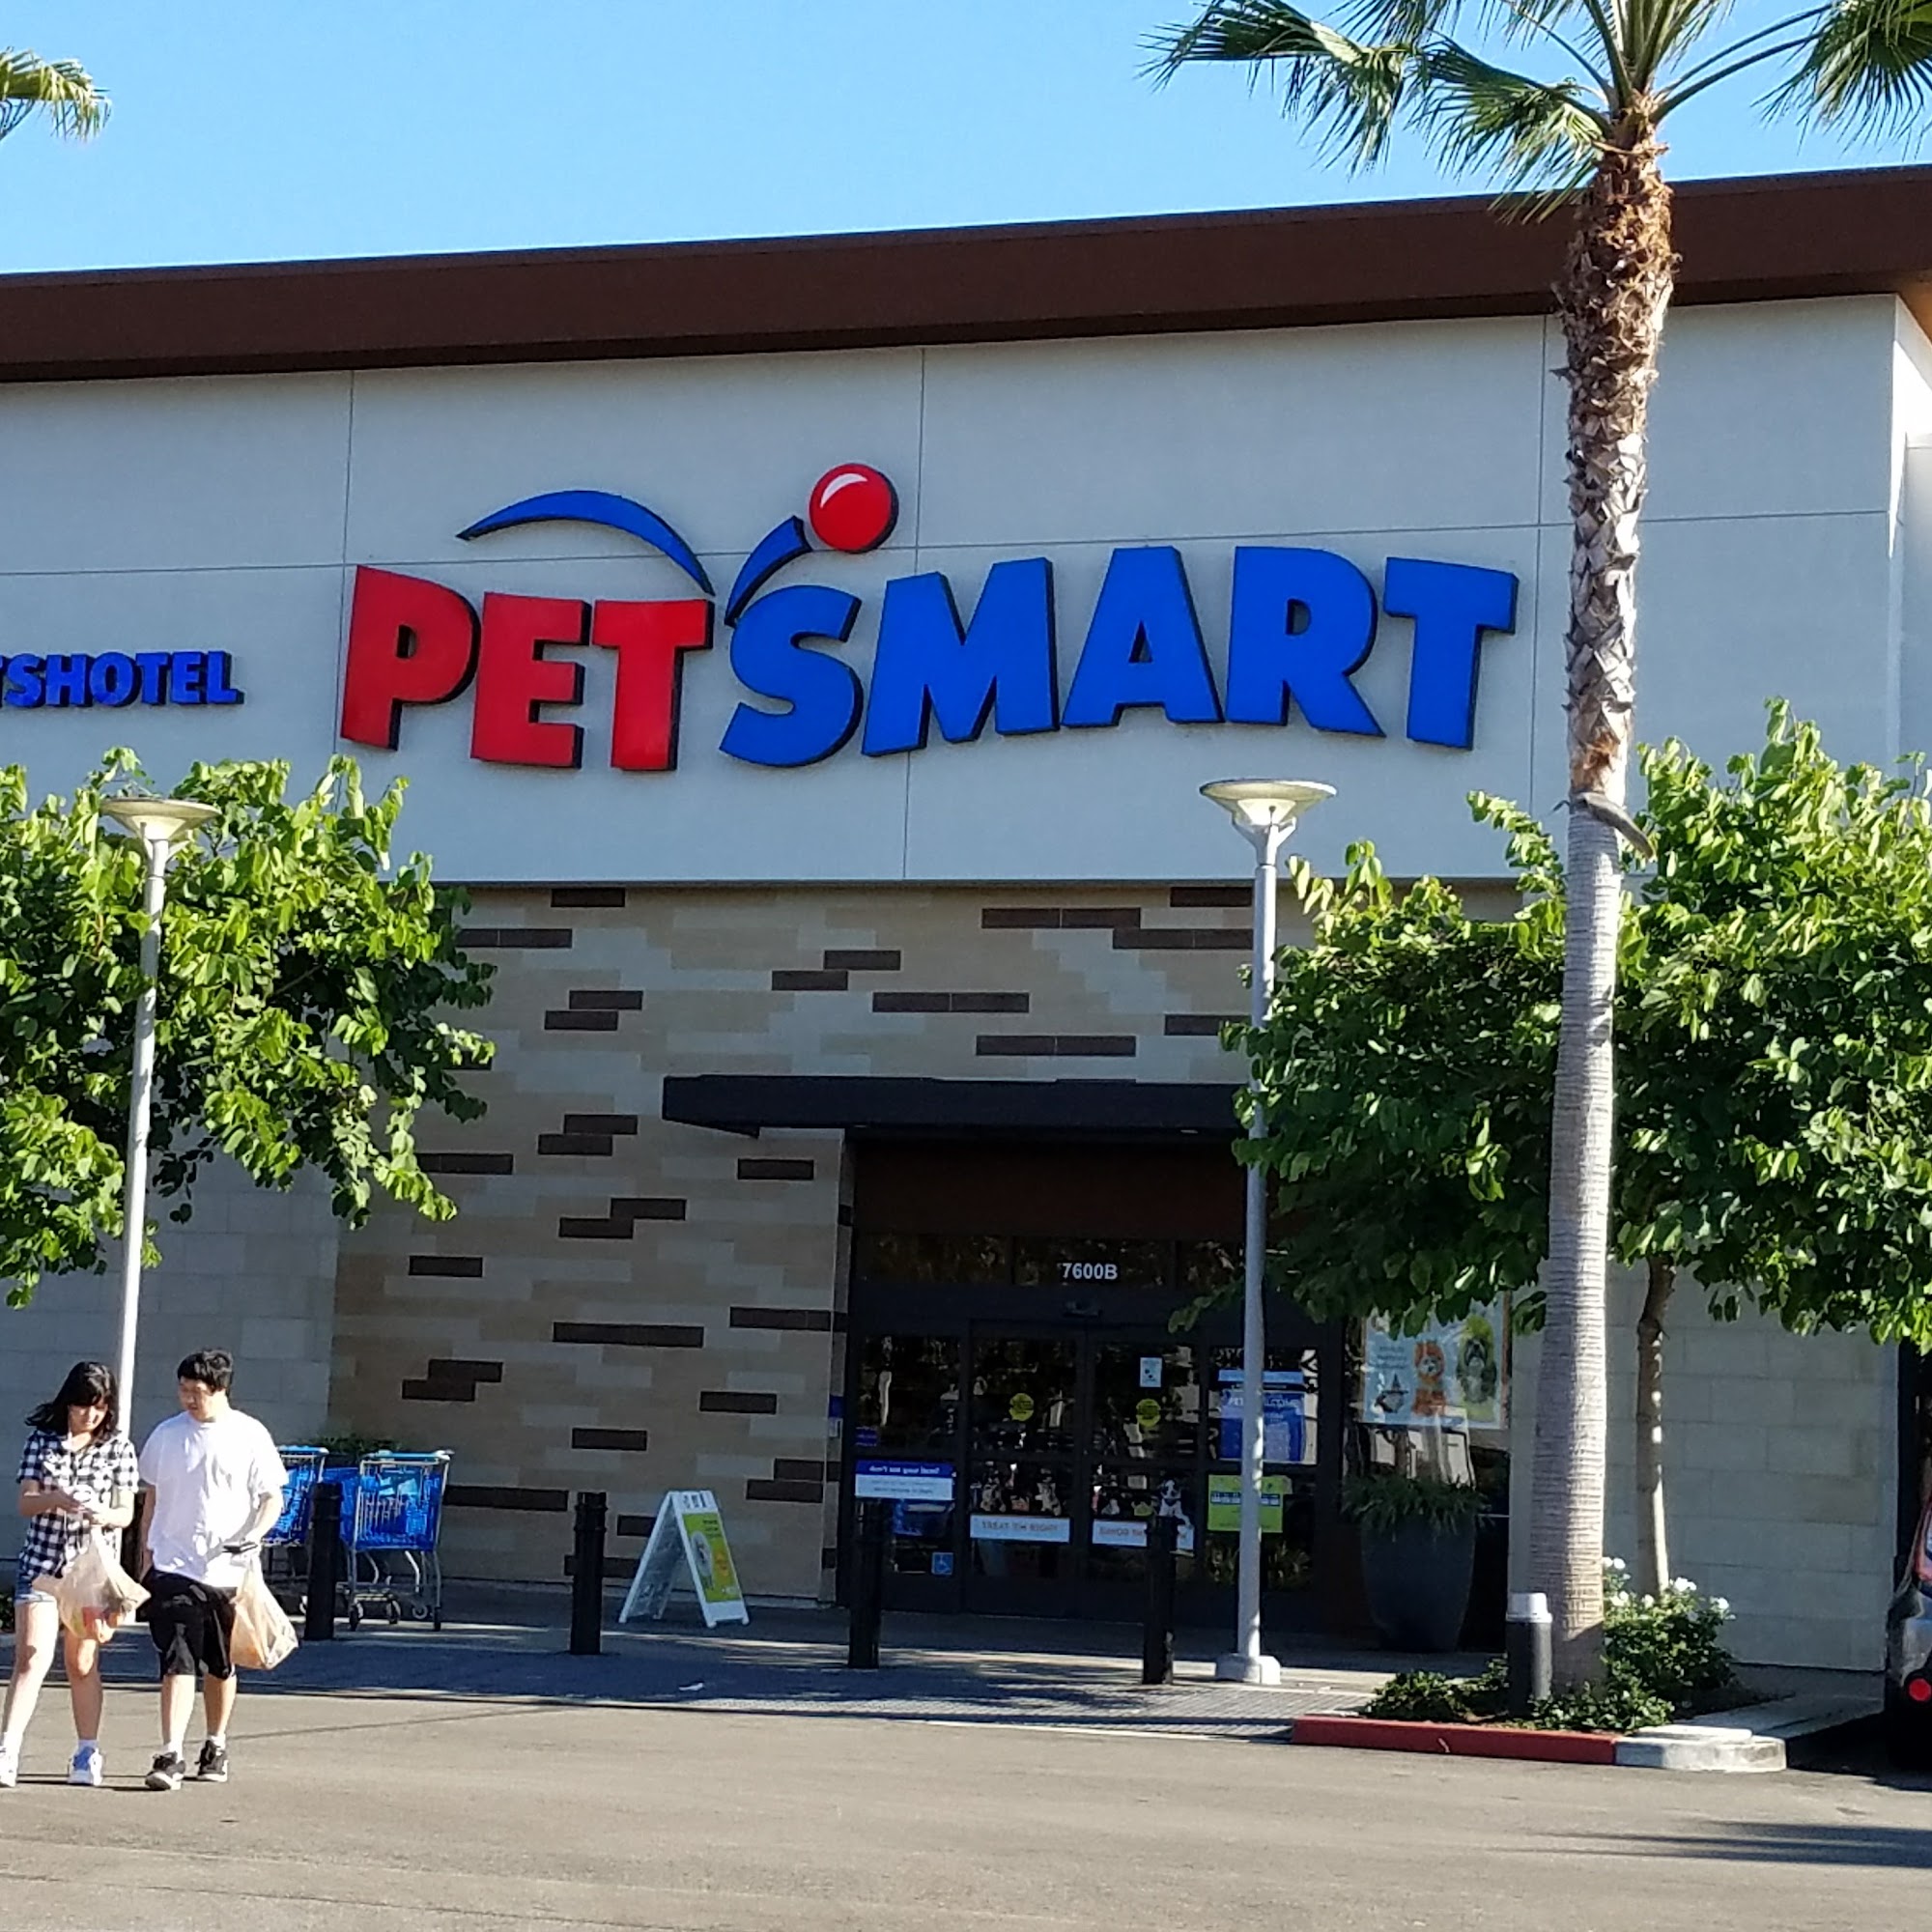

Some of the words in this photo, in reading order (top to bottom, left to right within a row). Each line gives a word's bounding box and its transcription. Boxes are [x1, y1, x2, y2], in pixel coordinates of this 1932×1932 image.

[0, 651, 244, 707] SHOTEL
[340, 545, 1520, 774] PETSMART
[1062, 1263, 1118, 1280] 7600B
